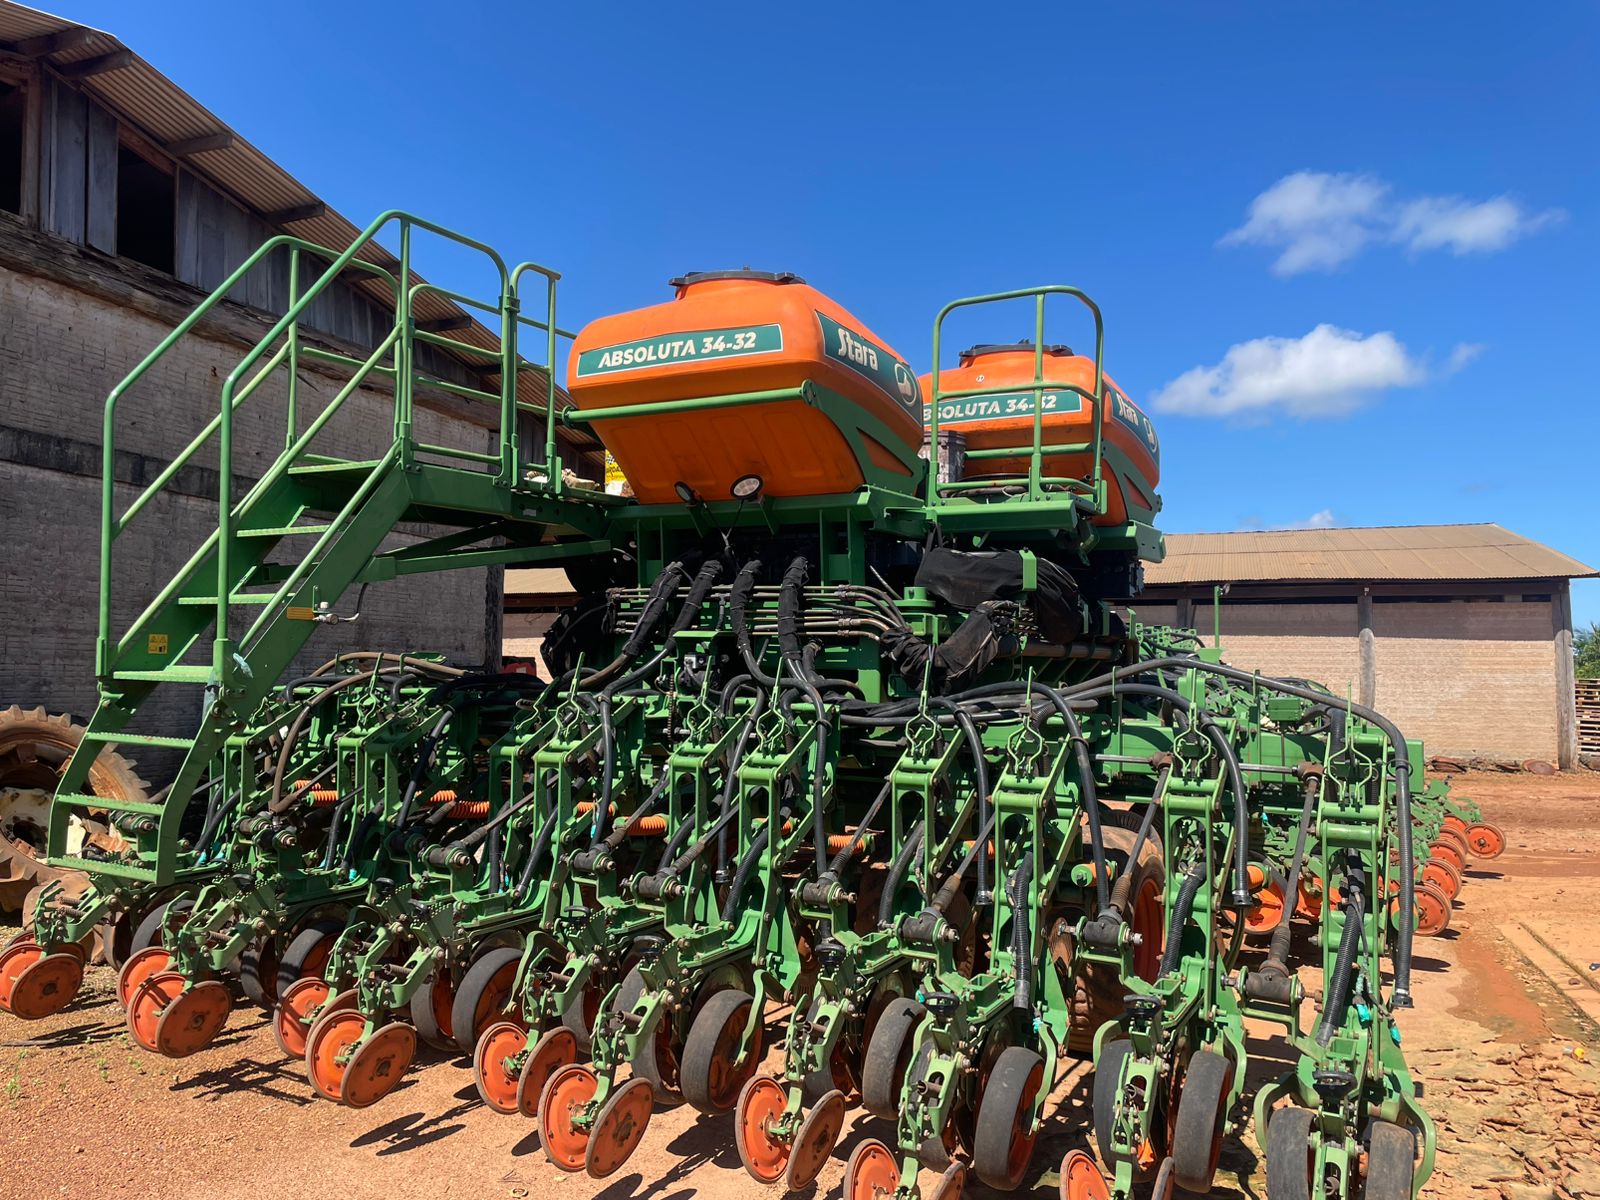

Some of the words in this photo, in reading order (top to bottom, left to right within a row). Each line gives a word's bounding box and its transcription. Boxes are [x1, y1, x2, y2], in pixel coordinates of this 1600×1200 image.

[597, 339, 696, 369] ABSOLUTA
[701, 332, 757, 354] 34-32
[837, 327, 878, 371] Stara
[923, 400, 1001, 421] BOLUTA
